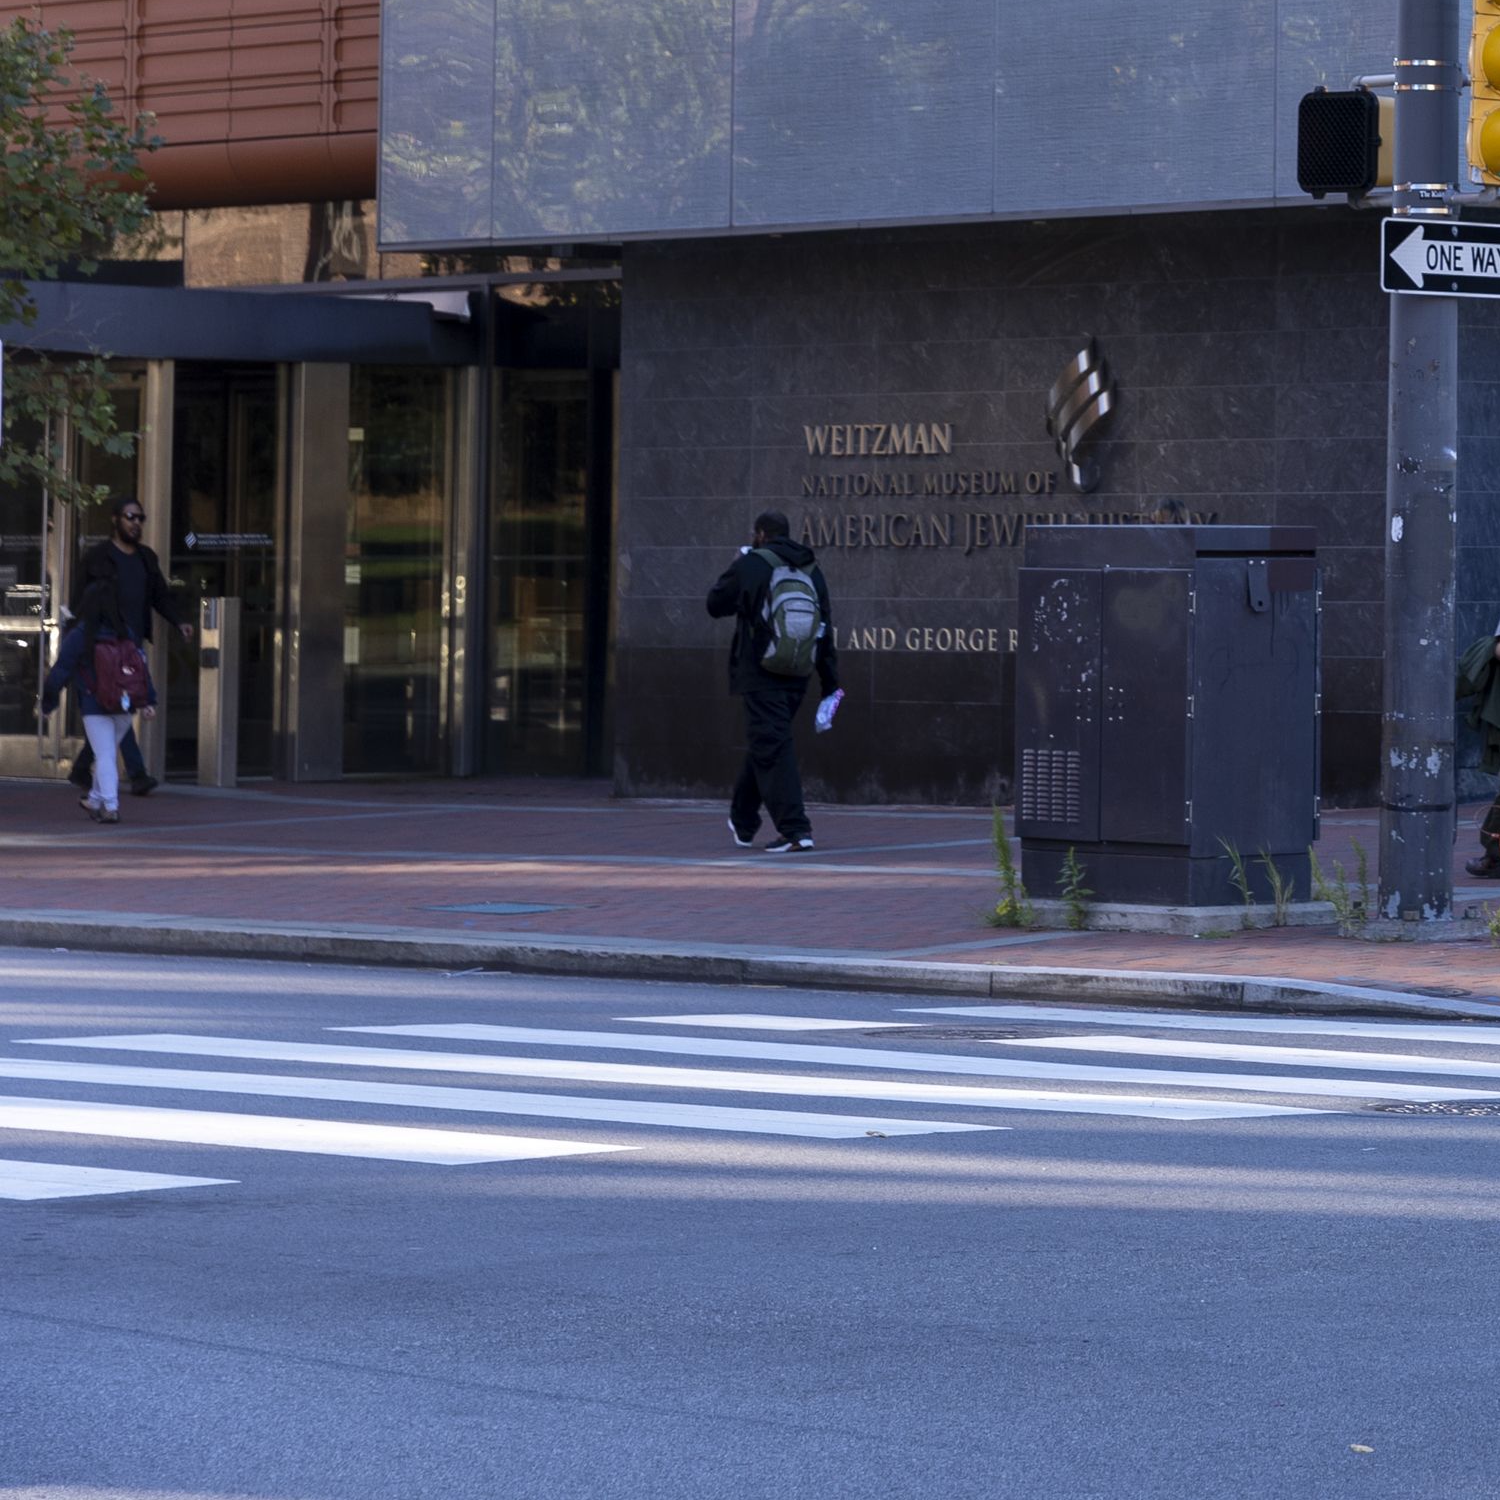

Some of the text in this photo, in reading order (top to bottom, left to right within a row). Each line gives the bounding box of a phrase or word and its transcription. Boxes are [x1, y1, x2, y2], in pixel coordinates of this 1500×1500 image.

[1426, 243, 1464, 272] ONE
[803, 422, 953, 456] WEITZMAN
[801, 470, 1057, 496] NATIONAL MUSEUM OF
[801, 513, 951, 548] AMERICAN
[847, 627, 897, 650] AND
[905, 627, 998, 651] GEORGE
